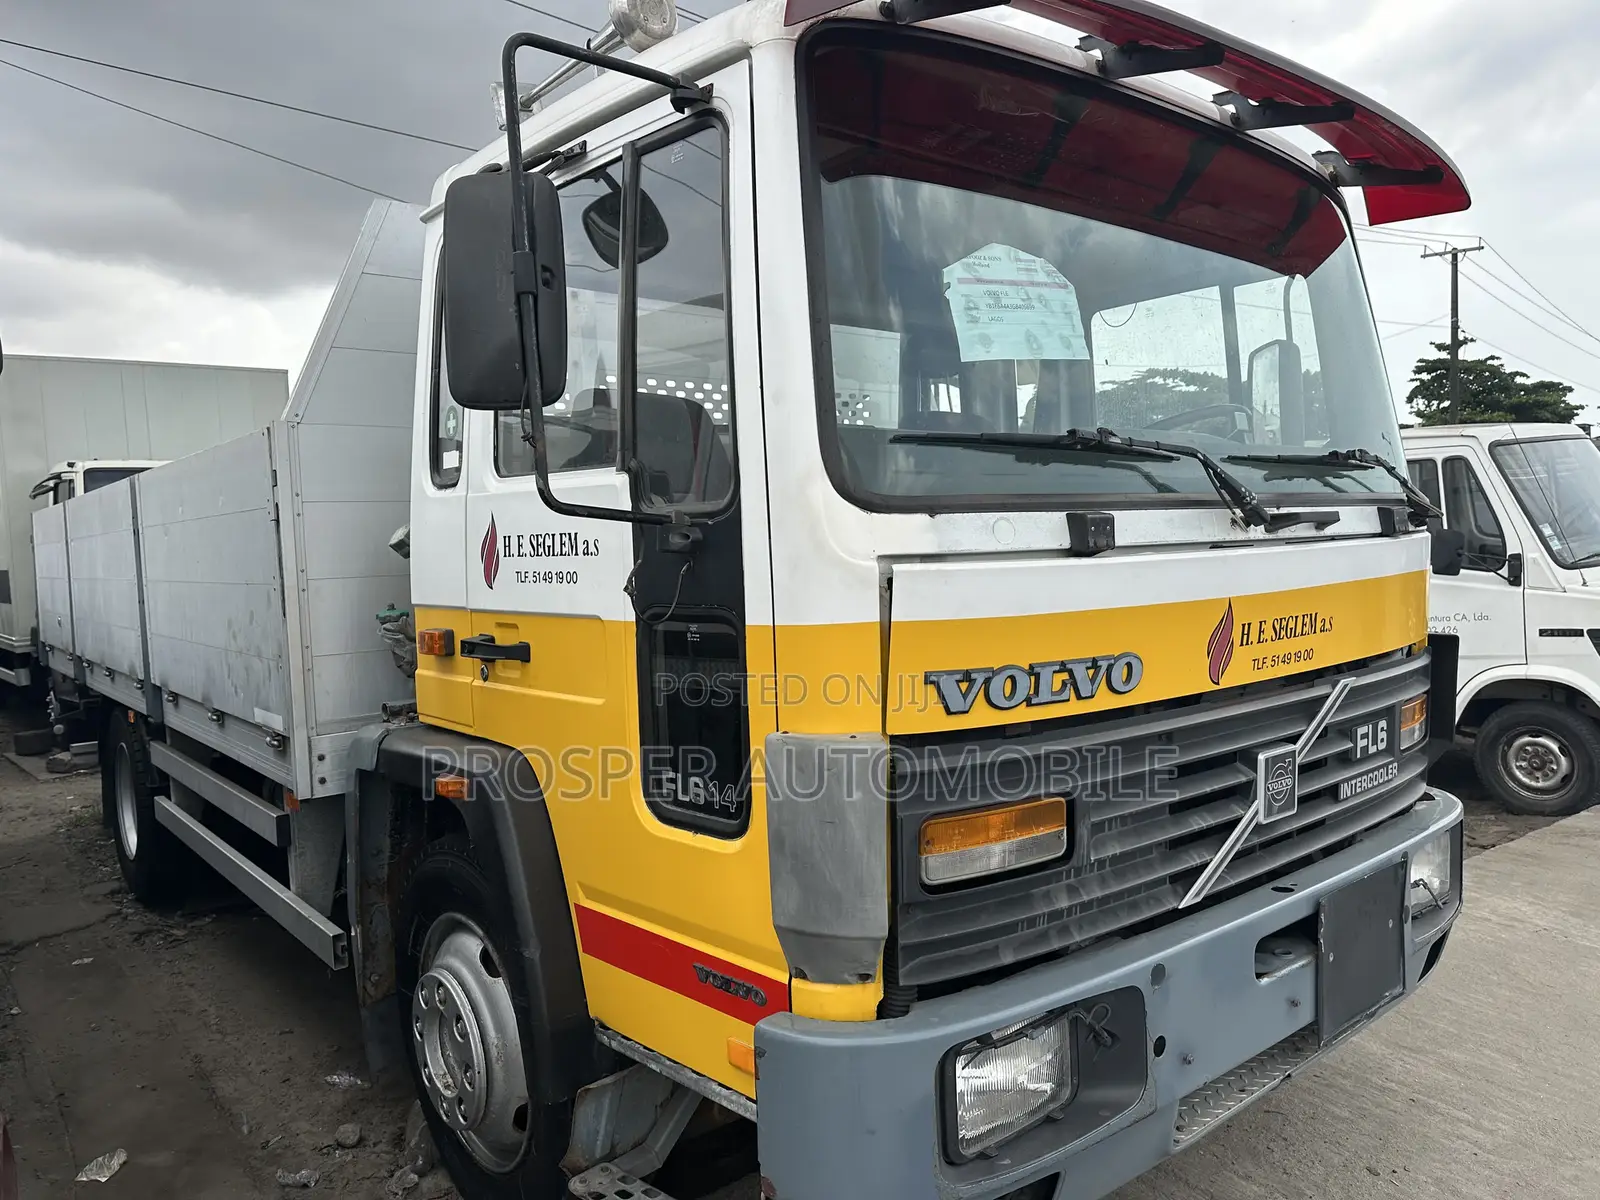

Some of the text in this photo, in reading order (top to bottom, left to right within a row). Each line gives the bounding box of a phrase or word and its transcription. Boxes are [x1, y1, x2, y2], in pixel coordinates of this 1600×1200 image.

[982, 289, 999, 297] VOLVO
[987, 315, 1004, 323] LAGOS
[529, 532, 579, 558] SEGLEM
[515, 571, 531, 584] TLF.
[1270, 612, 1319, 642] SEGLEM
[1427, 612, 1492, 623] ntura CA, Lda.
[1251, 656, 1269, 671] TLF.
[924, 651, 1143, 715] VOLVO
[1355, 718, 1388, 759] FL6
[662, 770, 737, 813] FL6 14
[1267, 778, 1292, 792] VOLVO
[1339, 762, 1398, 800] INTERCOOLER
[692, 961, 768, 1007] VOLVO
